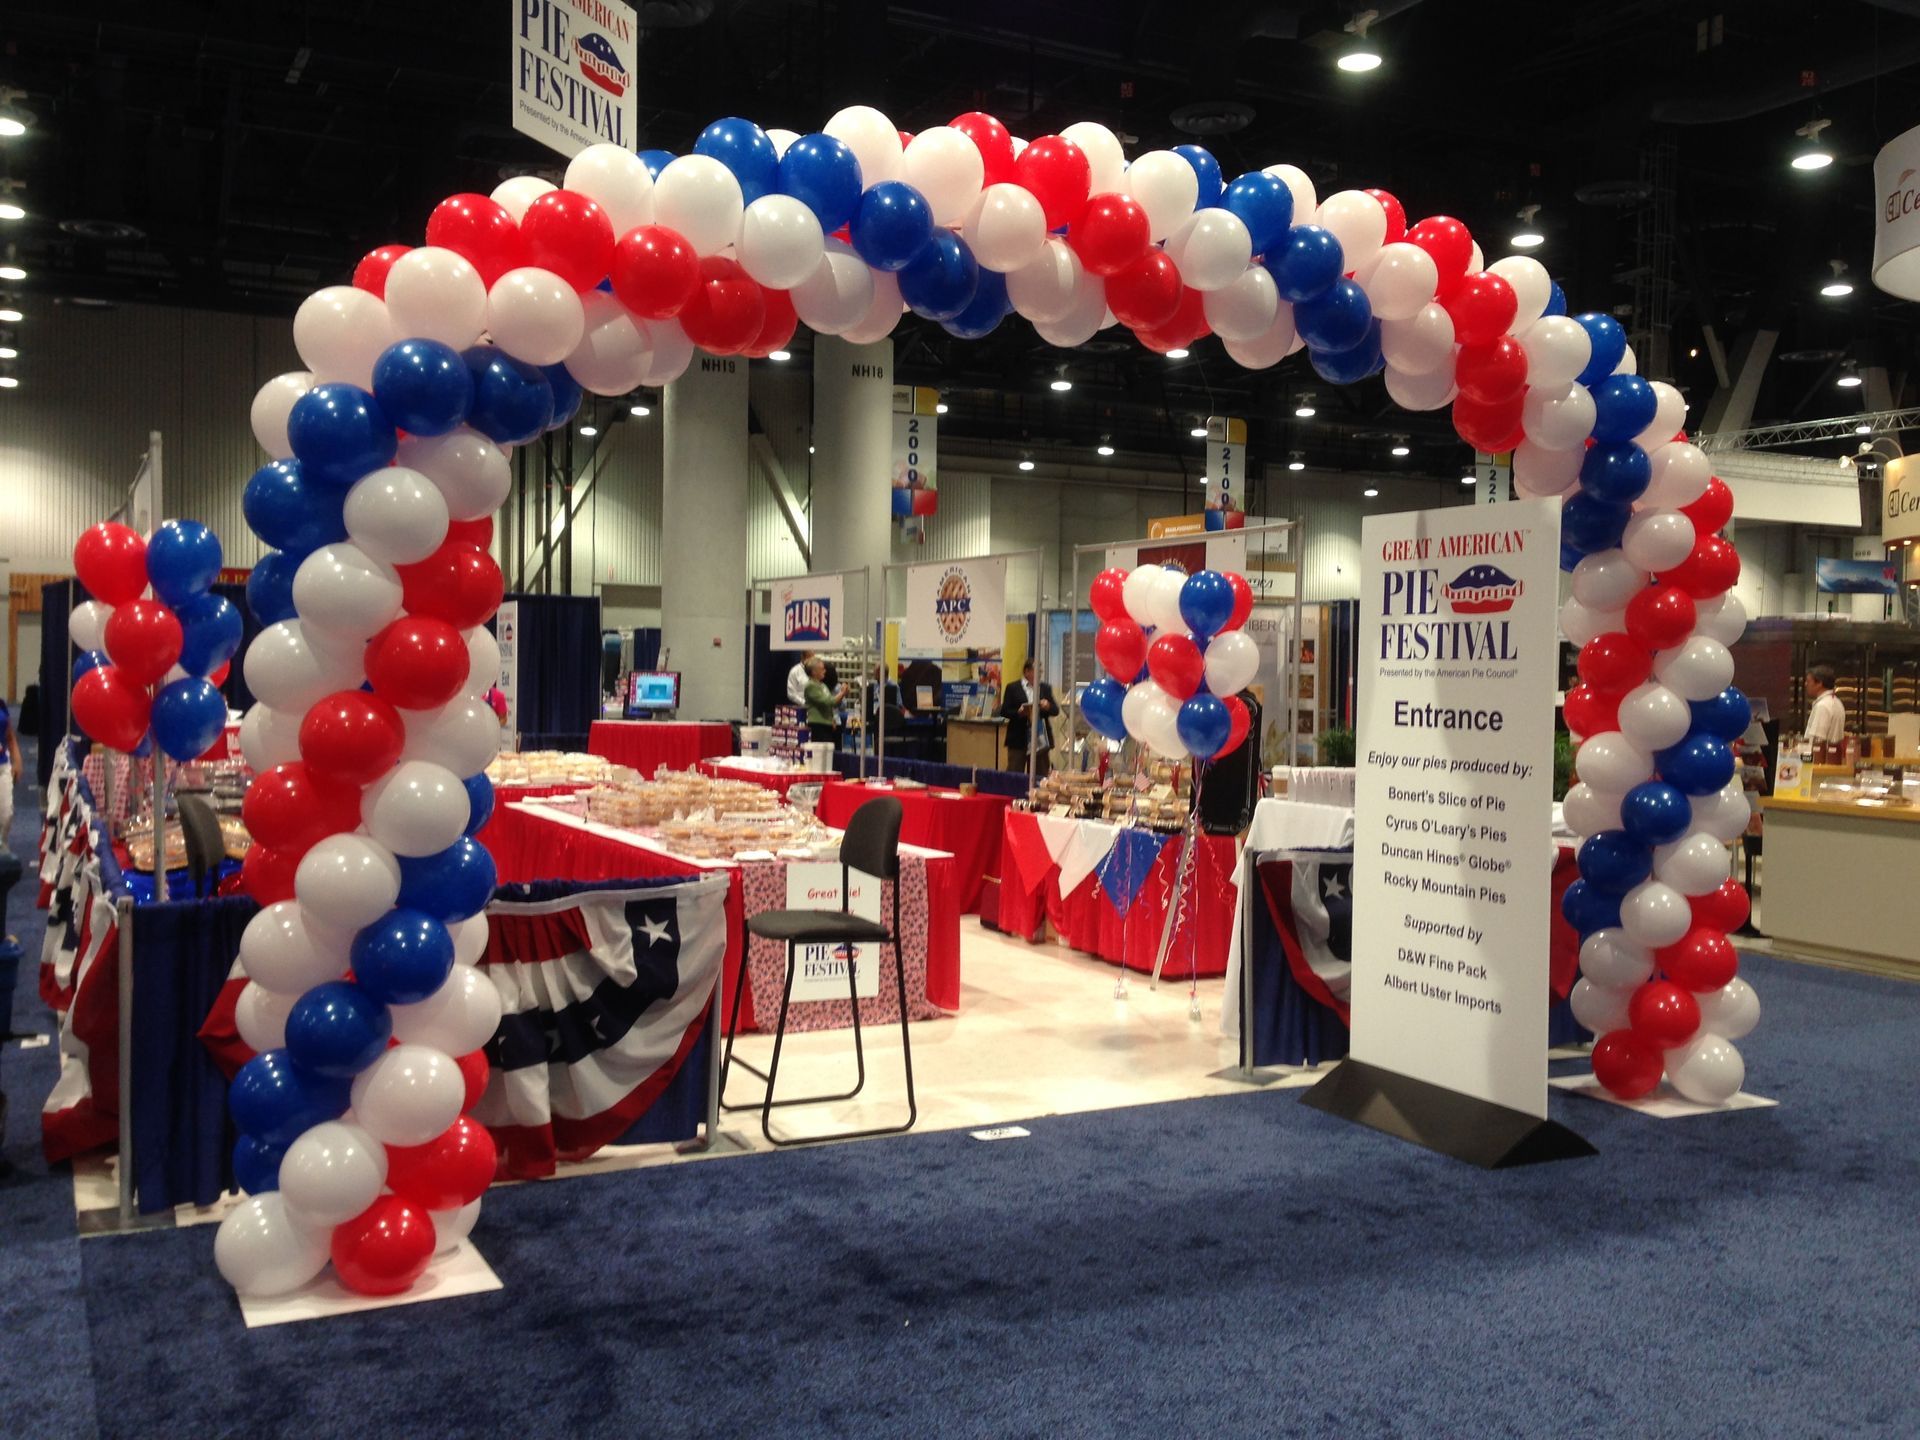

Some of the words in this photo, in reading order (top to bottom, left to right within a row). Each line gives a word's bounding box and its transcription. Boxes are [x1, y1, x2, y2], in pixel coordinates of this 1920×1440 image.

[519, 0, 570, 65] PIE
[572, 0, 630, 44] MERICAN
[518, 46, 628, 149] FESTIVAL
[519, 99, 551, 126] Presented
[551, 117, 559, 133] by
[701, 358, 736, 374] NH19
[851, 364, 884, 379] NH18
[907, 419, 919, 482] 2000
[1221, 447, 1231, 505] 2100
[1382, 538, 1432, 562] GREAT
[936, 566, 971, 597] AMERICAN
[1381, 568, 1439, 617] PIE
[785, 600, 829, 638] GLOBE
[940, 598, 967, 612] APC
[1379, 620, 1518, 661] FESTIVAL
[1379, 667, 1413, 678] Presented
[1414, 667, 1423, 680] by
[1425, 668, 1436, 678] the
[1437, 667, 1470, 679] American
[1472, 668, 1484, 679] Pie
[1394, 700, 1504, 732] Entrance
[1368, 750, 1399, 769] Enjoy
[1401, 756, 1421, 768] our
[1422, 755, 1447, 771] pies
[1450, 758, 1510, 775] produced
[1512, 761, 1533, 780] by:
[1388, 786, 1435, 804] Bonert's
[1438, 791, 1467, 808] Slice
[1470, 794, 1485, 809] of
[1486, 796, 1506, 812] Pie
[1386, 814, 1418, 832] Cyrus
[1421, 818, 1477, 841] O'Leary's
[1480, 826, 1507, 843] Pies
[1381, 842, 1424, 861] Duncan
[807, 887, 838, 900] Great
[1384, 871, 1418, 892] Rocky
[1421, 877, 1476, 899] Mountain
[1480, 887, 1506, 905] Pies
[1404, 914, 1465, 939] Supported
[1467, 925, 1483, 945] by
[805, 944, 830, 962] PIE
[1398, 947, 1426, 966] D&W
[1429, 954, 1454, 973] Fine
[1457, 960, 1487, 980] Pack
[1384, 973, 1417, 994] Albert
[1421, 981, 1451, 1001] Uster
[1455, 990, 1502, 1015] Imports
